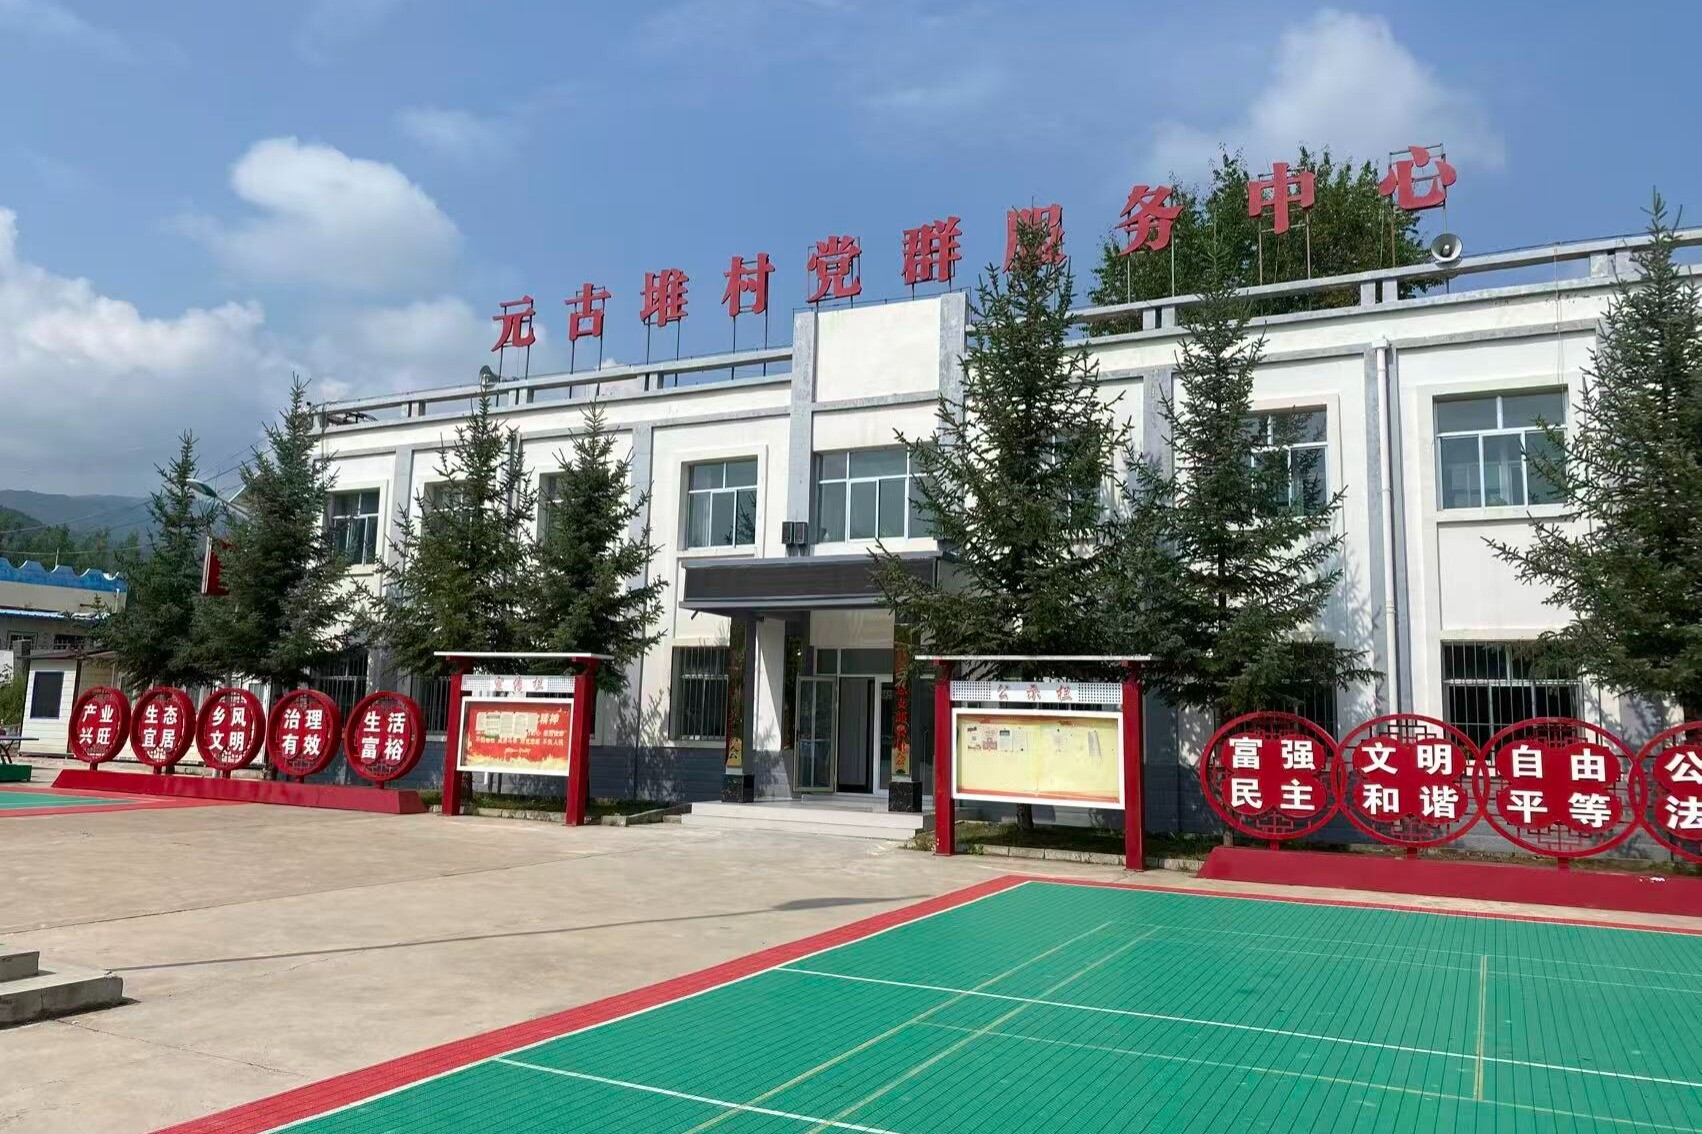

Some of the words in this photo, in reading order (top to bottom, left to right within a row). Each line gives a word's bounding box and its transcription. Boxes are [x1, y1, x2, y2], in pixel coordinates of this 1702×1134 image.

[997, 683, 1073, 702] 公示栏
[83, 704, 113, 723] 产业
[145, 705, 178, 724] 生态
[213, 704, 246, 726] 乡风
[284, 709, 322, 730] 治理
[364, 711, 405, 733] 生活
[80, 727, 111, 745] 兴旺
[142, 728, 176, 749] 宜居
[208, 730, 245, 752] 文明
[282, 734, 320, 756] 有效
[362, 737, 403, 761] 富裕
[1229, 737, 1316, 771] 富强
[1361, 741, 1453, 775] 文明
[1511, 744, 1607, 782] 自由
[1230, 778, 1315, 812] 民主
[1363, 783, 1459, 819] 和谐
[1507, 790, 1612, 829] 平等
